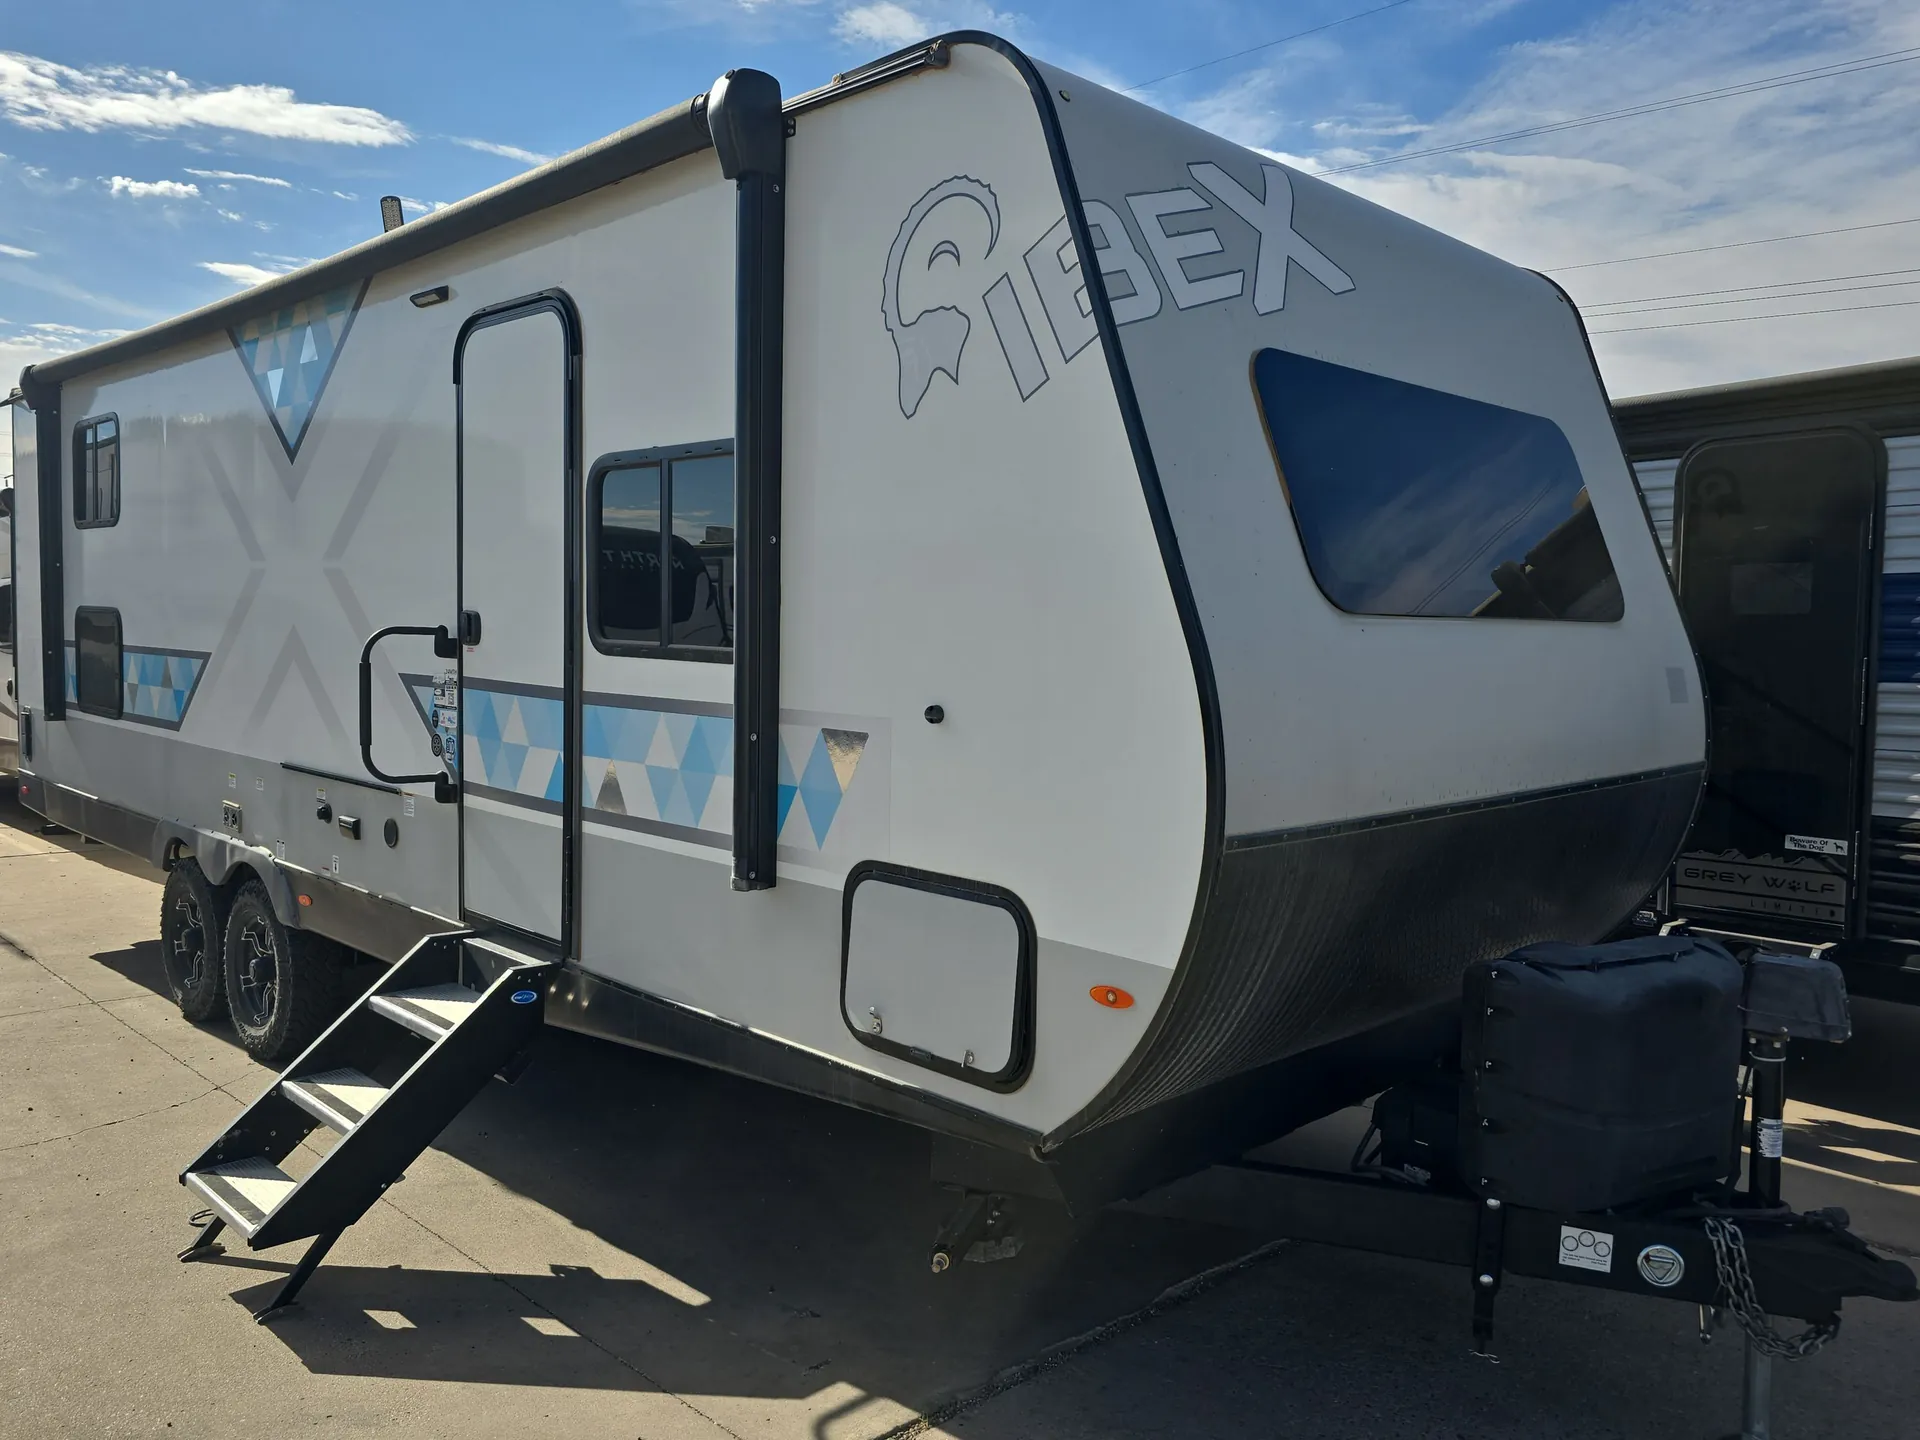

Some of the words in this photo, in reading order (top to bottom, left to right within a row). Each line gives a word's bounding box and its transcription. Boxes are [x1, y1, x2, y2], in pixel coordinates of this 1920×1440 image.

[983, 161, 1356, 402] IBEX
[1789, 836, 1818, 845] Beware
[1808, 844, 1825, 852] Dog
[1684, 867, 1753, 885] GREY
[1763, 875, 1836, 894] WLF
